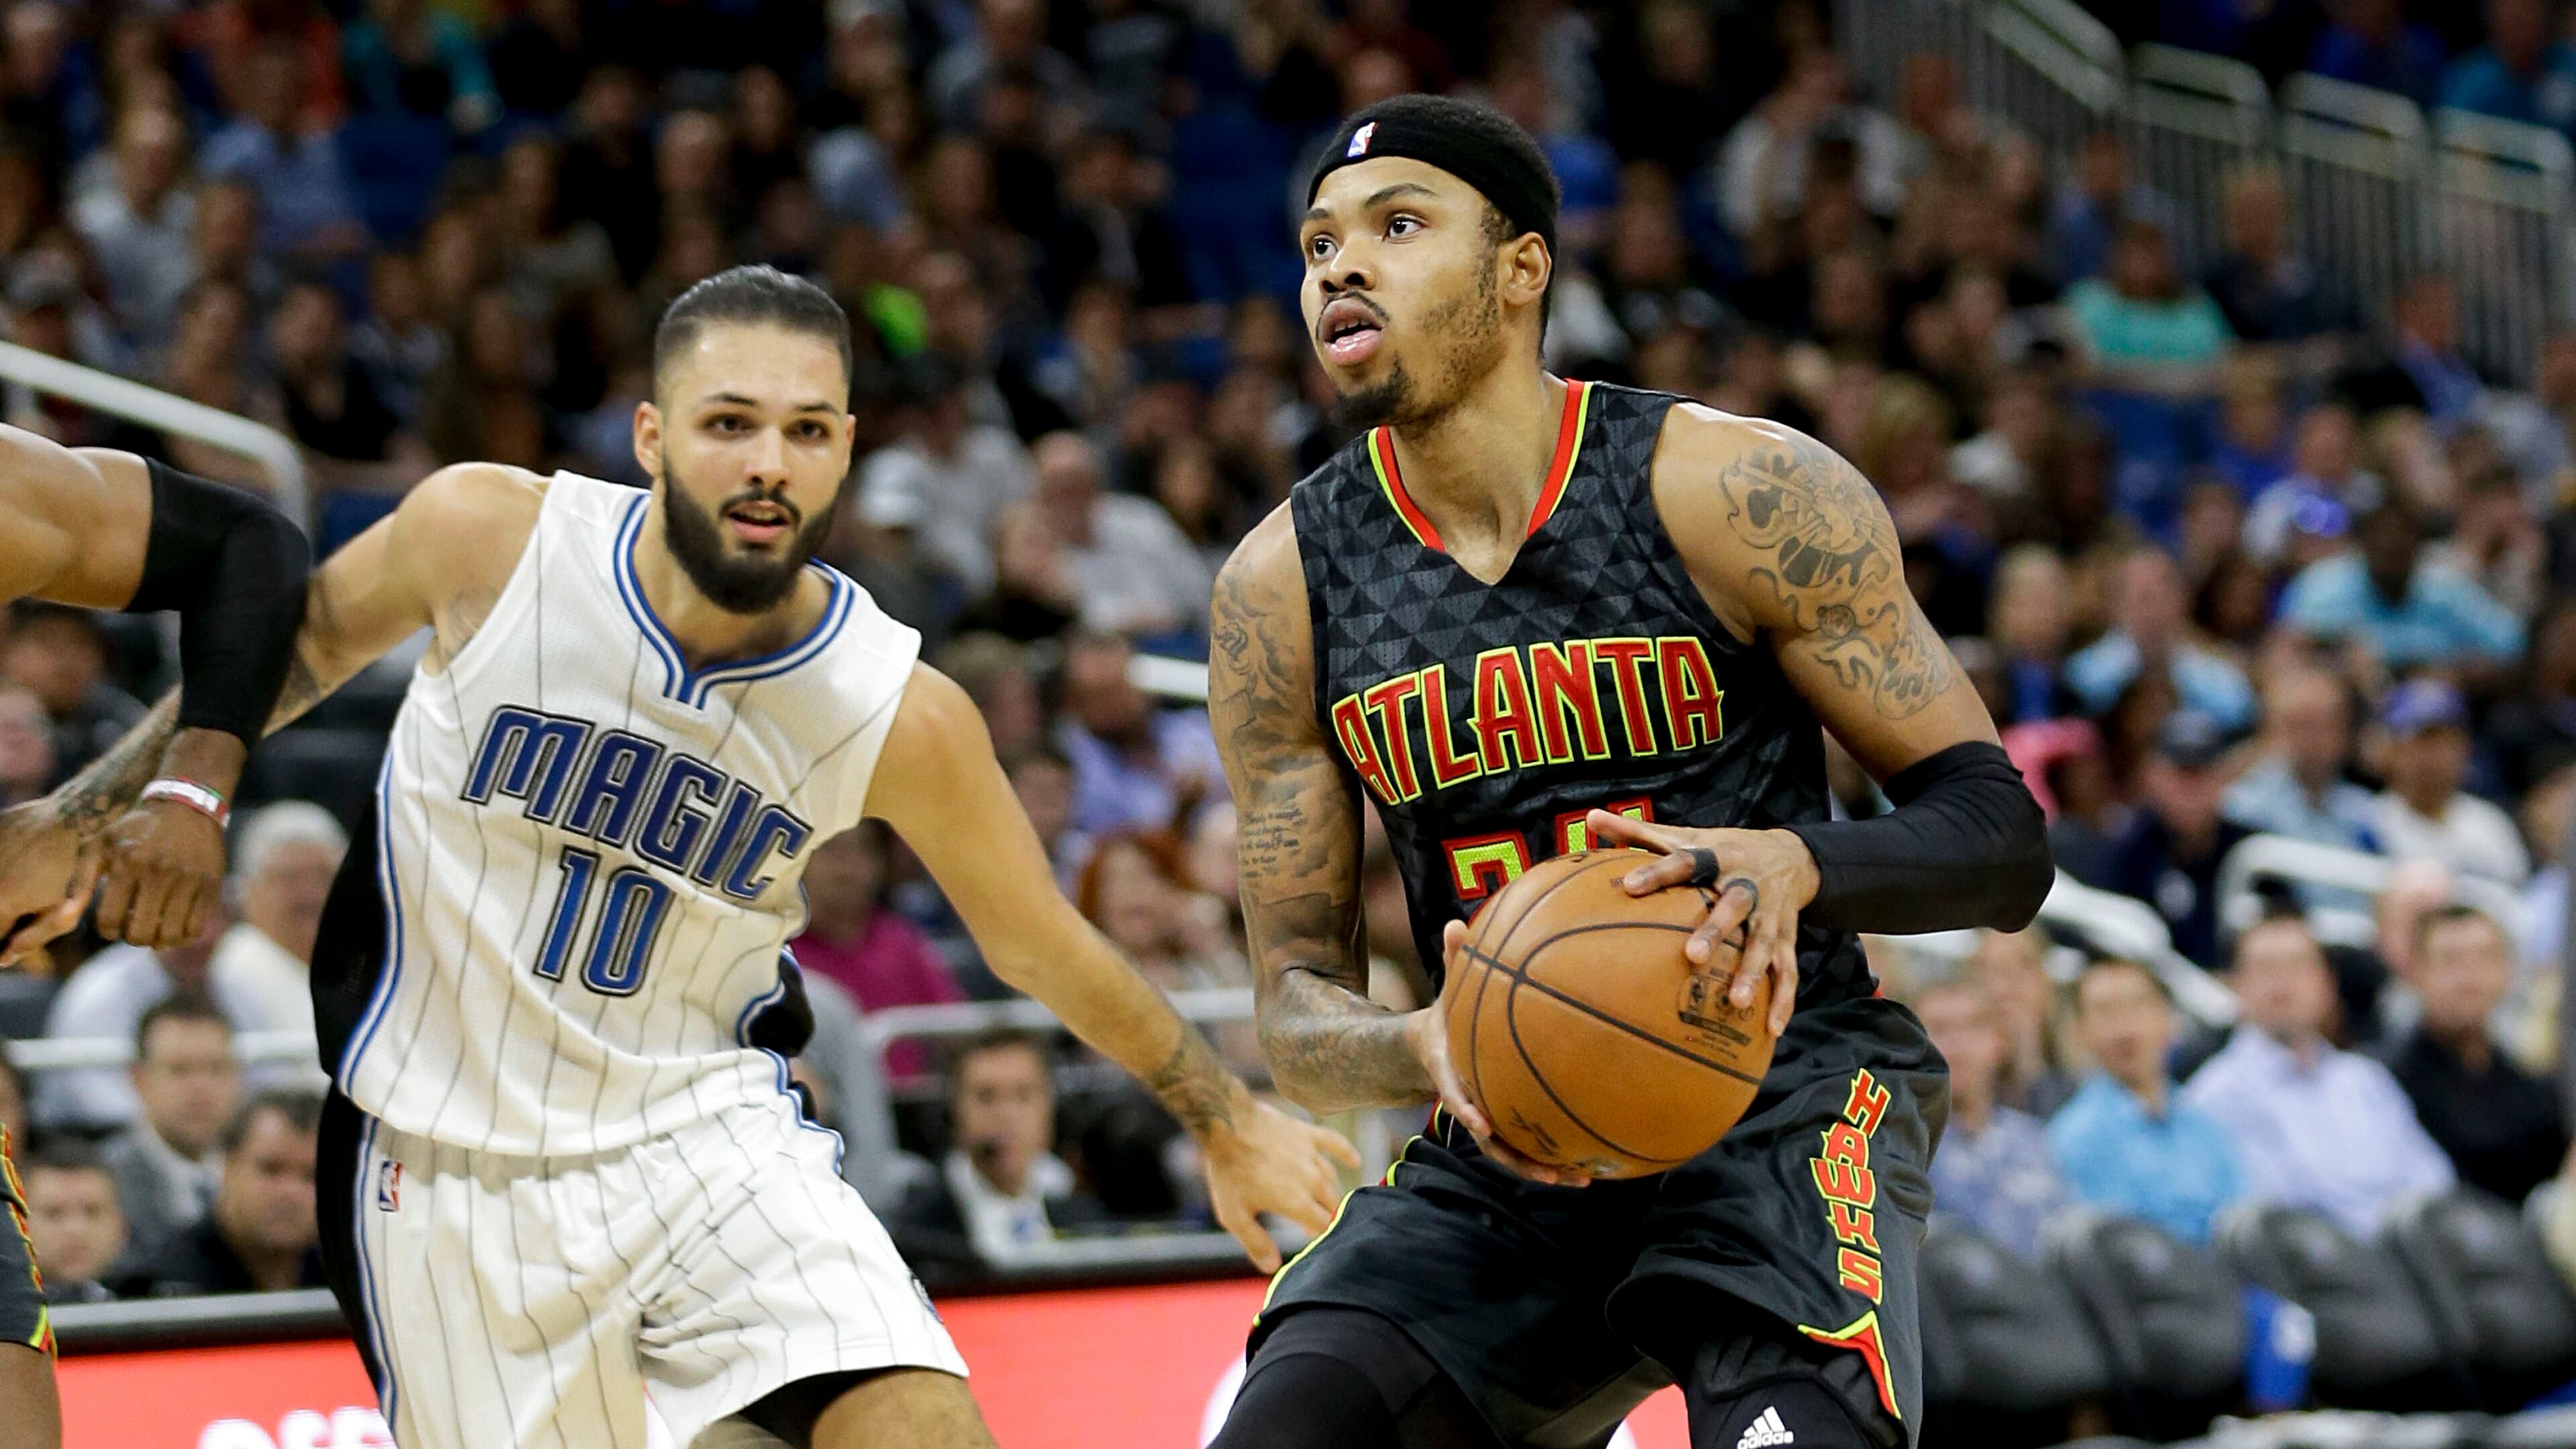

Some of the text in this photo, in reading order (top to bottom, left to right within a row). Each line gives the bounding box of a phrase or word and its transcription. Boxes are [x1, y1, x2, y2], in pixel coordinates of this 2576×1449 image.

[460, 704, 814, 900] MAGIC
[1332, 636, 1725, 805] ATLANTA
[533, 845, 677, 997] 10
[1809, 1067, 1892, 1305] HAWKS
[1737, 1431, 1794, 1449] adidas
